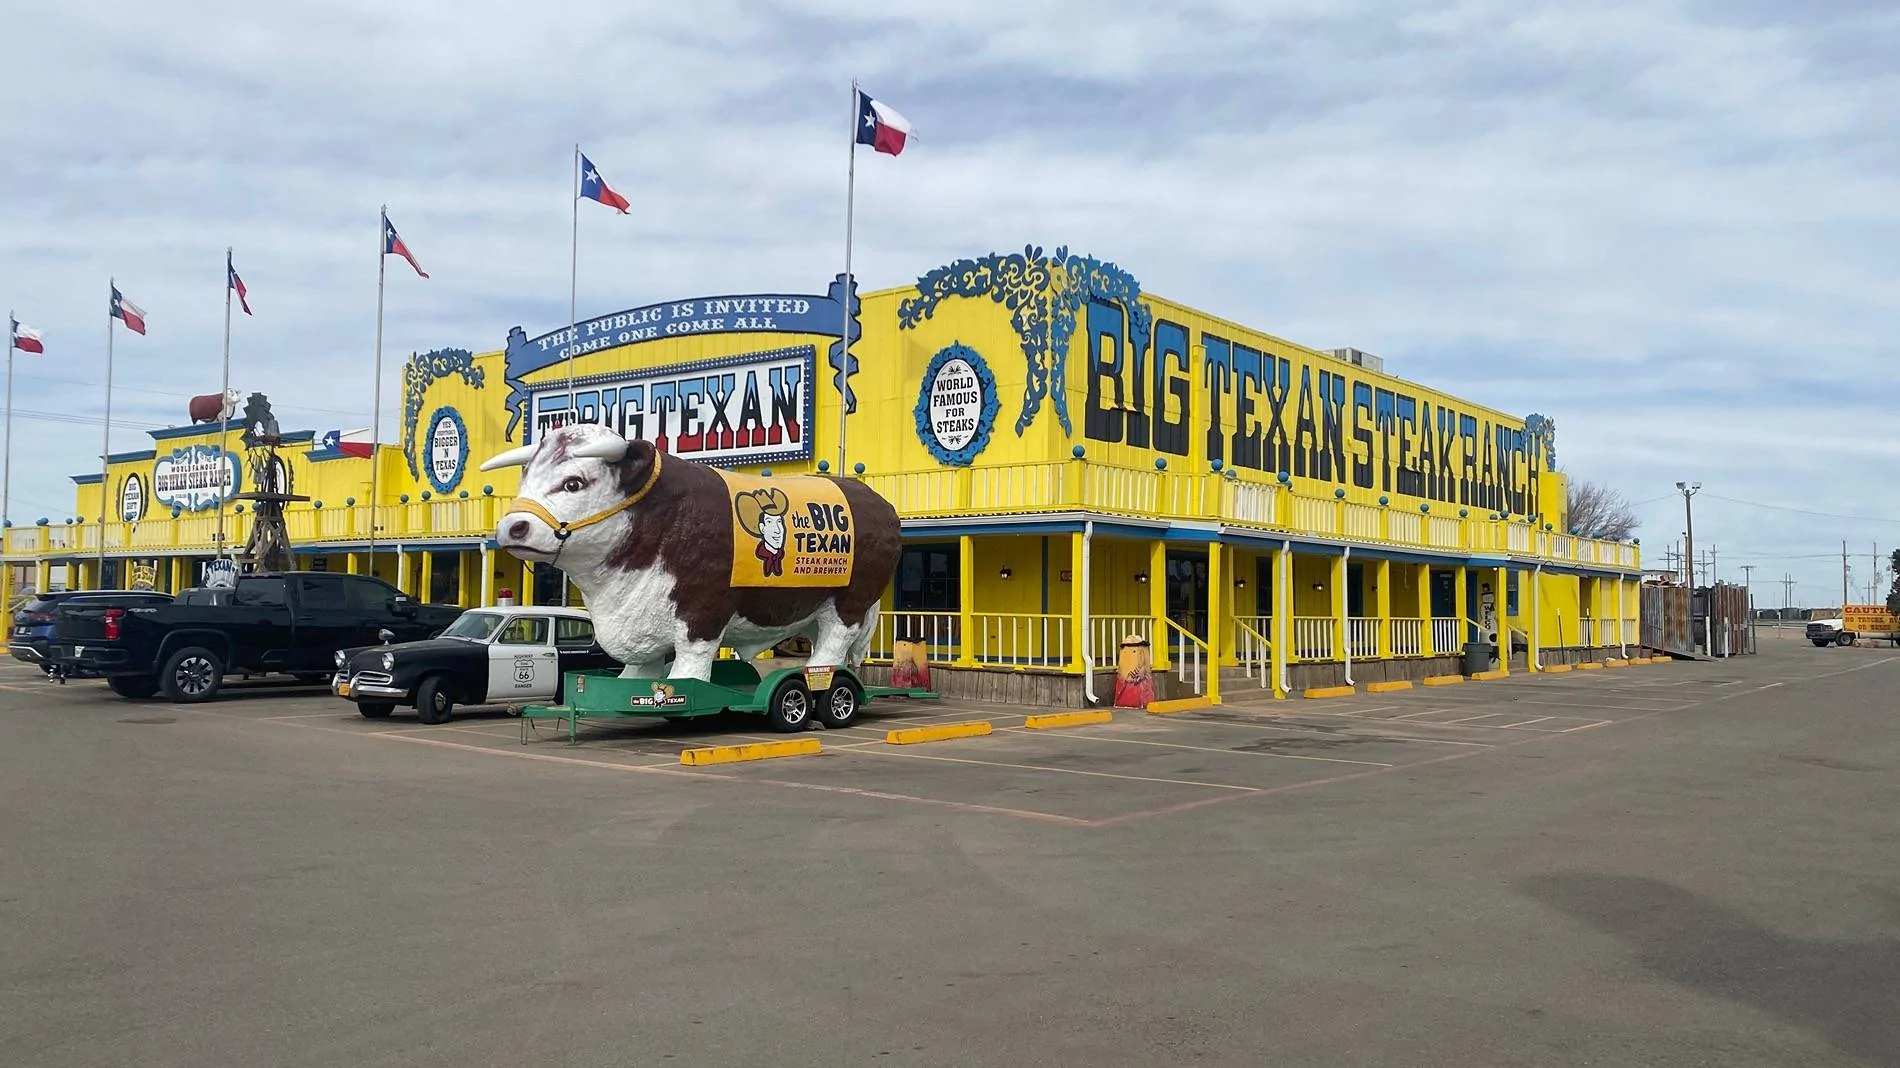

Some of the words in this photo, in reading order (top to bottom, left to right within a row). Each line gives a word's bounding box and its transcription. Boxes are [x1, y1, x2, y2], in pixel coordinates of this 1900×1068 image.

[538, 328, 578, 351] THE
[587, 307, 661, 336] PUBLIC
[671, 302, 694, 319] IS
[704, 299, 810, 315] INVITED
[560, 336, 610, 359] COME
[618, 326, 657, 343] ONE
[665, 318, 724, 335] COME
[734, 317, 777, 330] ALL
[937, 377, 973, 391] WORLD
[933, 391, 978, 407] FAMOUS
[1085, 298, 1190, 456] BIG
[1201, 331, 1346, 485] TEXAN
[1353, 380, 1455, 505] STEAK
[1460, 412, 1541, 518] RANCH
[651, 364, 801, 455] TEXAN
[945, 408, 965, 418] FOR
[936, 418, 974, 433] STEAKS
[434, 436, 458, 447] BIGGER
[436, 460, 456, 470] TEXAS
[792, 510, 810, 528] the
[806, 502, 848, 532] BIG
[794, 532, 850, 554] TEXAN
